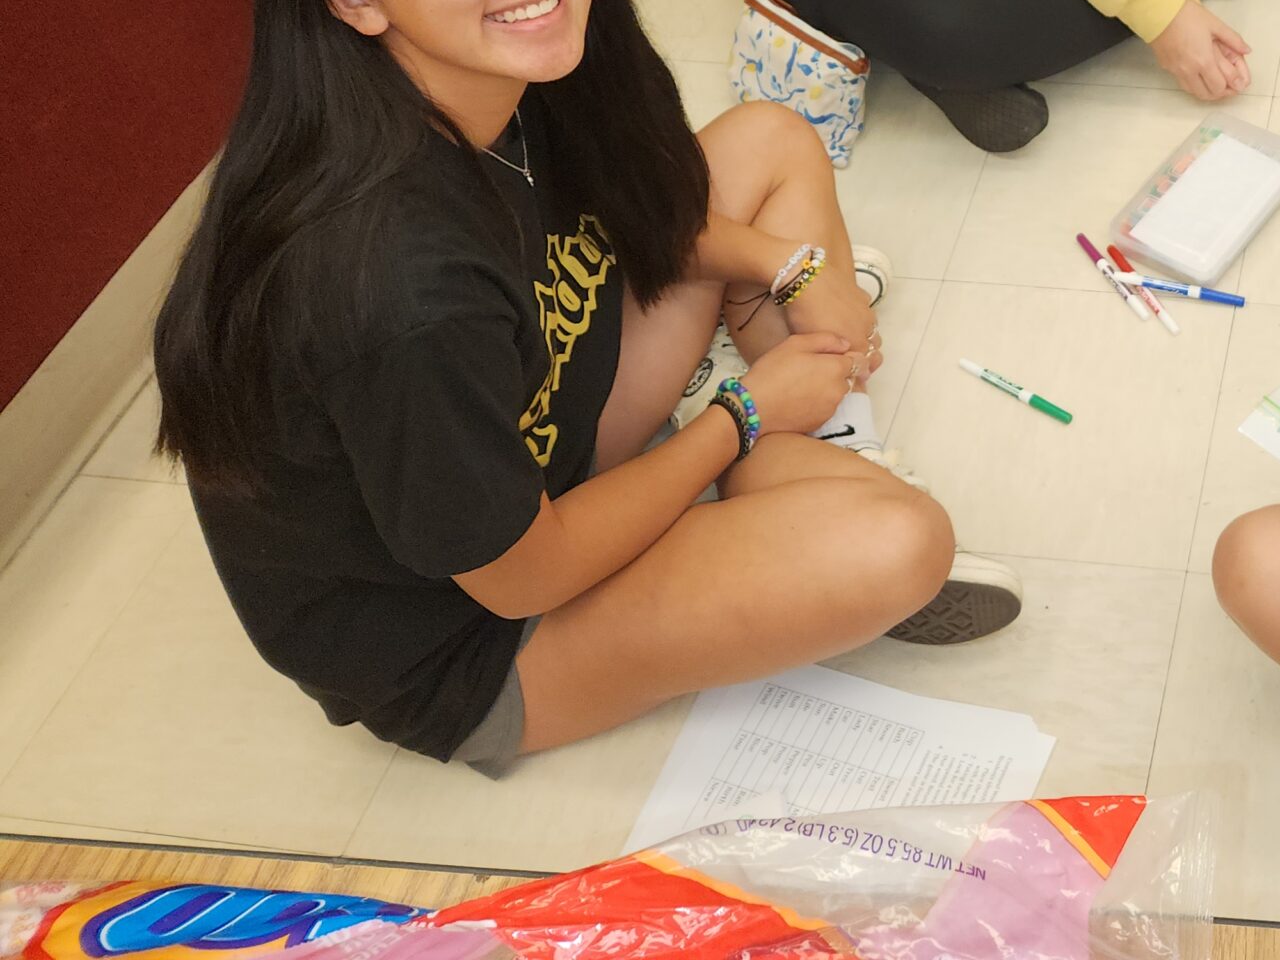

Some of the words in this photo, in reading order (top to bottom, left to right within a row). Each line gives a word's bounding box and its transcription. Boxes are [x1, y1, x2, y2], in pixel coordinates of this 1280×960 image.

[824, 706, 838, 725] Make
[851, 713, 864, 731] Lady
[797, 821, 825, 839] LB)
[826, 825, 860, 847] (5.3
[859, 831, 884, 854] OZ
[885, 838, 922, 864] 85.5
[924, 851, 953, 871] WT
[955, 861, 987, 881] NET
